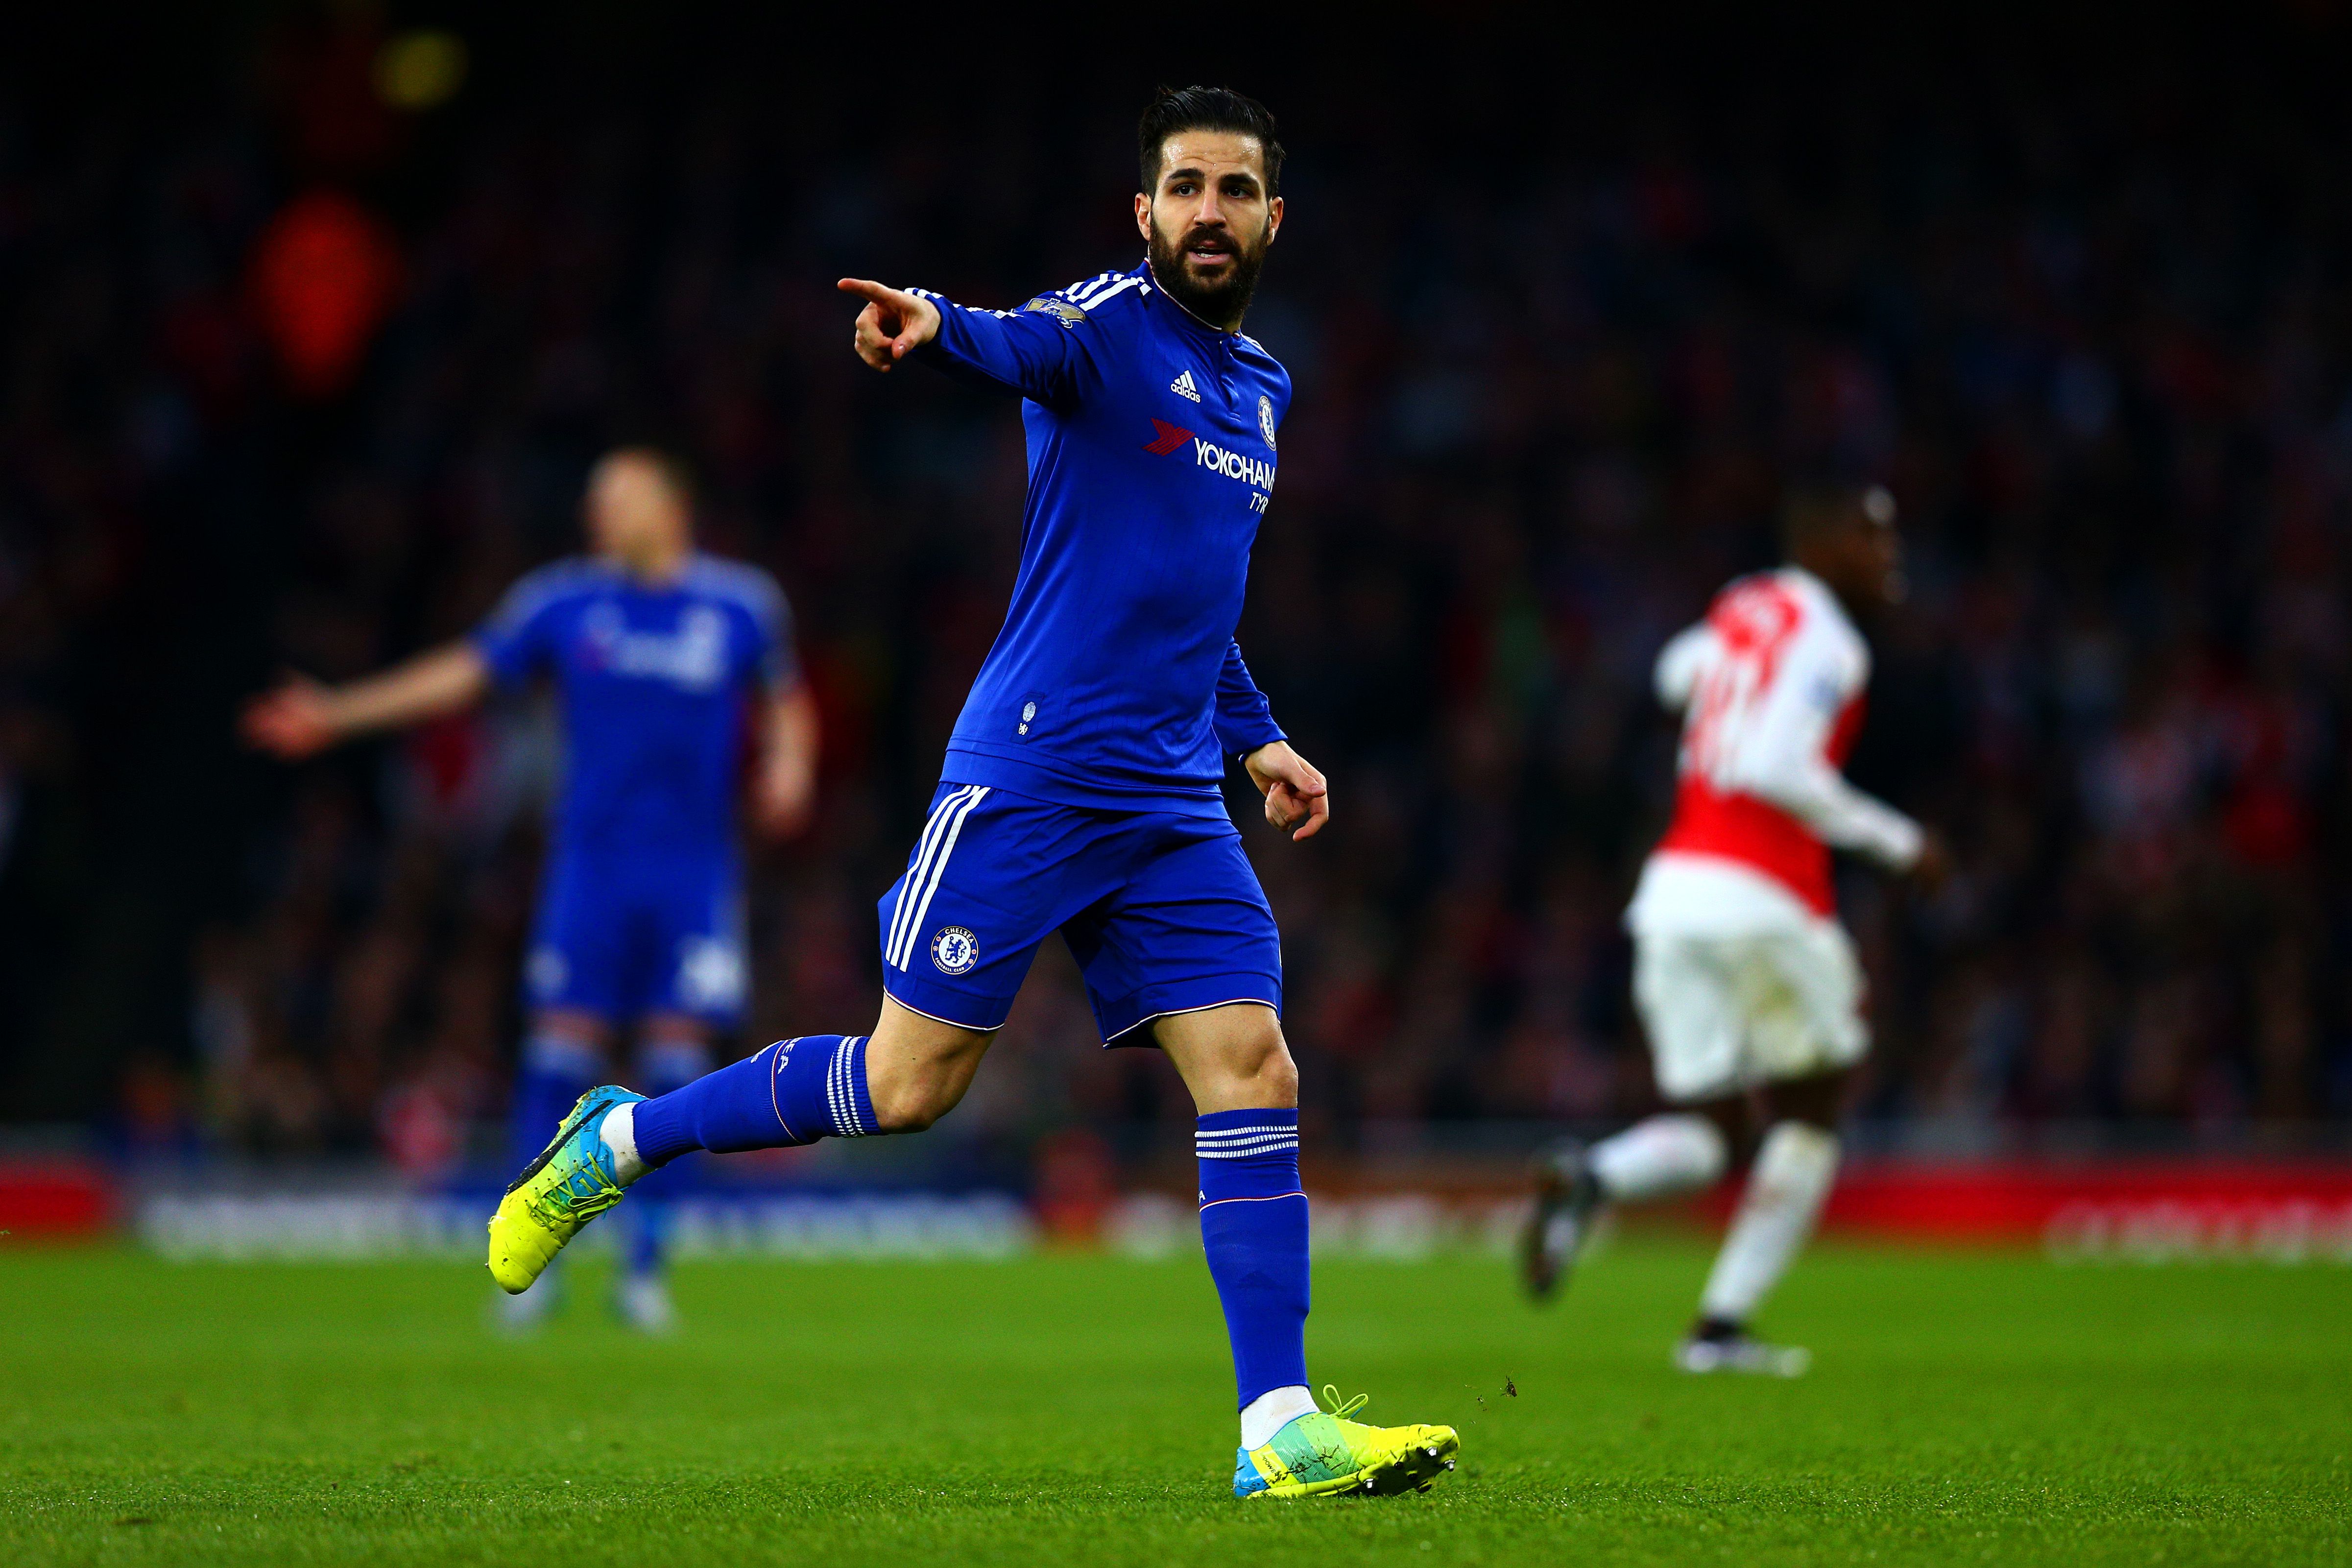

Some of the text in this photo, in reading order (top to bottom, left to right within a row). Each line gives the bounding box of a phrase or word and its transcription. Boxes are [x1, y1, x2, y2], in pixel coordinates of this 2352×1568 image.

[1171, 384, 1200, 403] adidas
[1194, 437, 1275, 493] YOKOHAM
[1249, 492, 1269, 515] TYR
[945, 928, 974, 943] CHELSEA
